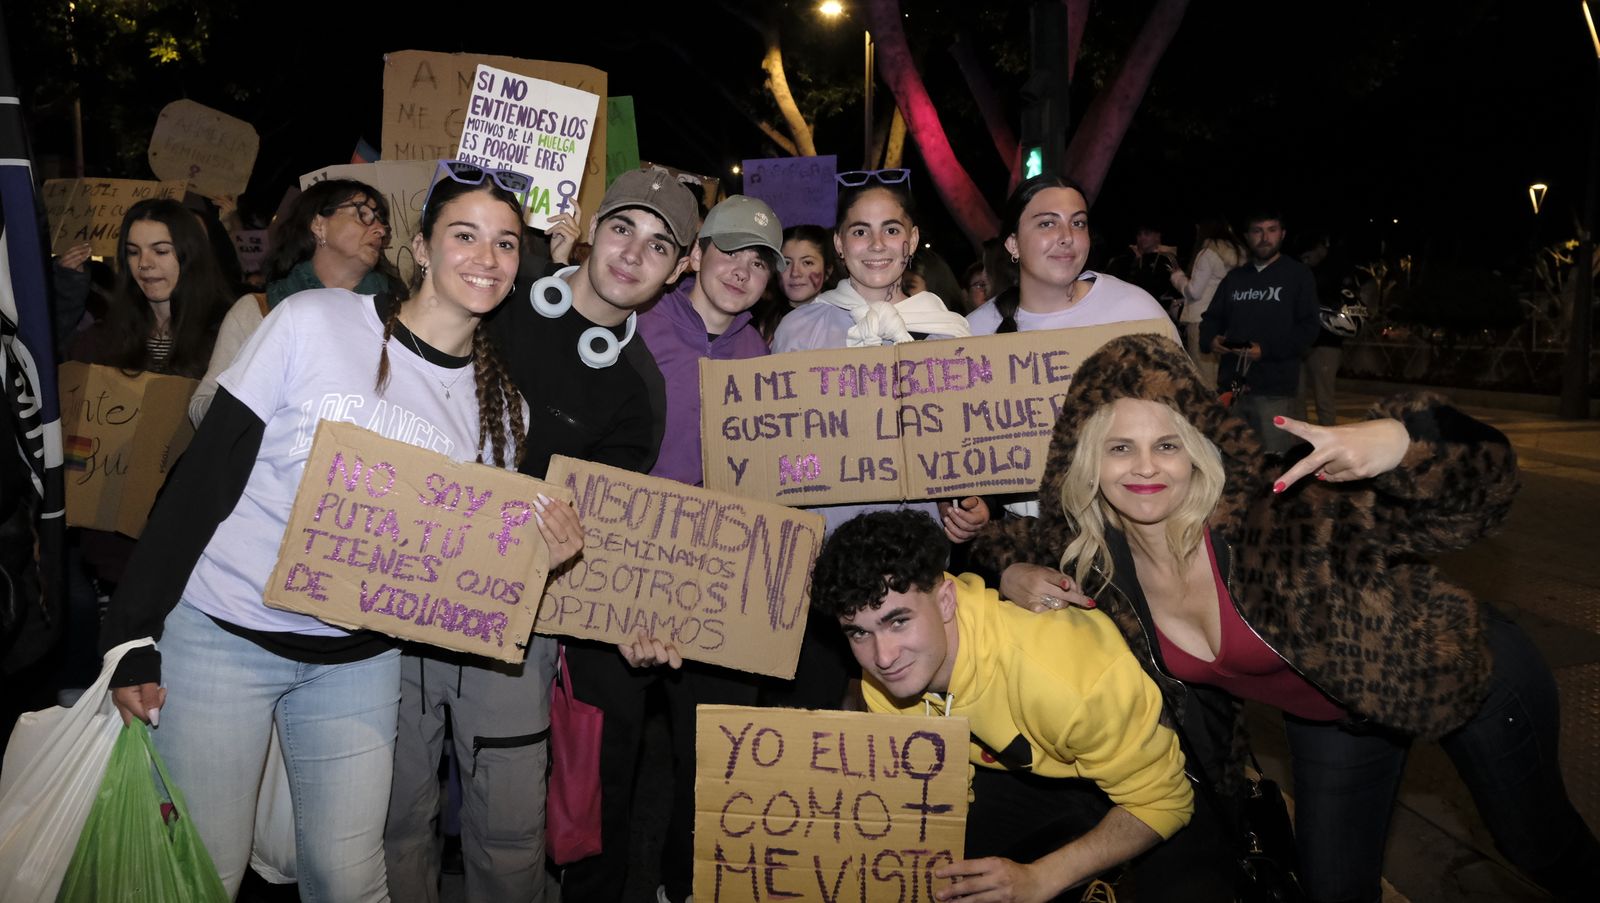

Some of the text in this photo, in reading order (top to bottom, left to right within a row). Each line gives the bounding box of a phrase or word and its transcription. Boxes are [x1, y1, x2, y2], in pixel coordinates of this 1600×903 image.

[410, 59, 438, 96] A
[477, 70, 528, 101] SI NO
[466, 117, 505, 138] MOTIVOS
[507, 128, 519, 141] DE
[522, 130, 533, 144] LA
[537, 133, 576, 153] HUELGA
[470, 94, 559, 134] ENTIENDES
[560, 114, 589, 140] LOS
[462, 132, 479, 151] ES
[482, 137, 531, 165] PORQUE
[534, 148, 567, 172] ERES
[84, 204, 107, 217] ME
[131, 186, 151, 198] NO
[722, 346, 1073, 405] A MI TAMBIÉN ME
[721, 408, 850, 442] GUSTAN
[875, 403, 944, 441] LAS
[327, 450, 494, 518] NO SOY
[726, 455, 749, 486] Y
[778, 453, 822, 486] NO
[840, 456, 898, 482] LAS
[564, 471, 820, 632] NOSOTROS NO
[284, 562, 333, 602] DE
[455, 569, 526, 607] OJOS
[553, 557, 731, 615] OSOTROS
[537, 591, 726, 651] OPINAMOS
[718, 722, 785, 785] YO
[719, 783, 892, 844] COMO
[713, 839, 806, 903] ME
